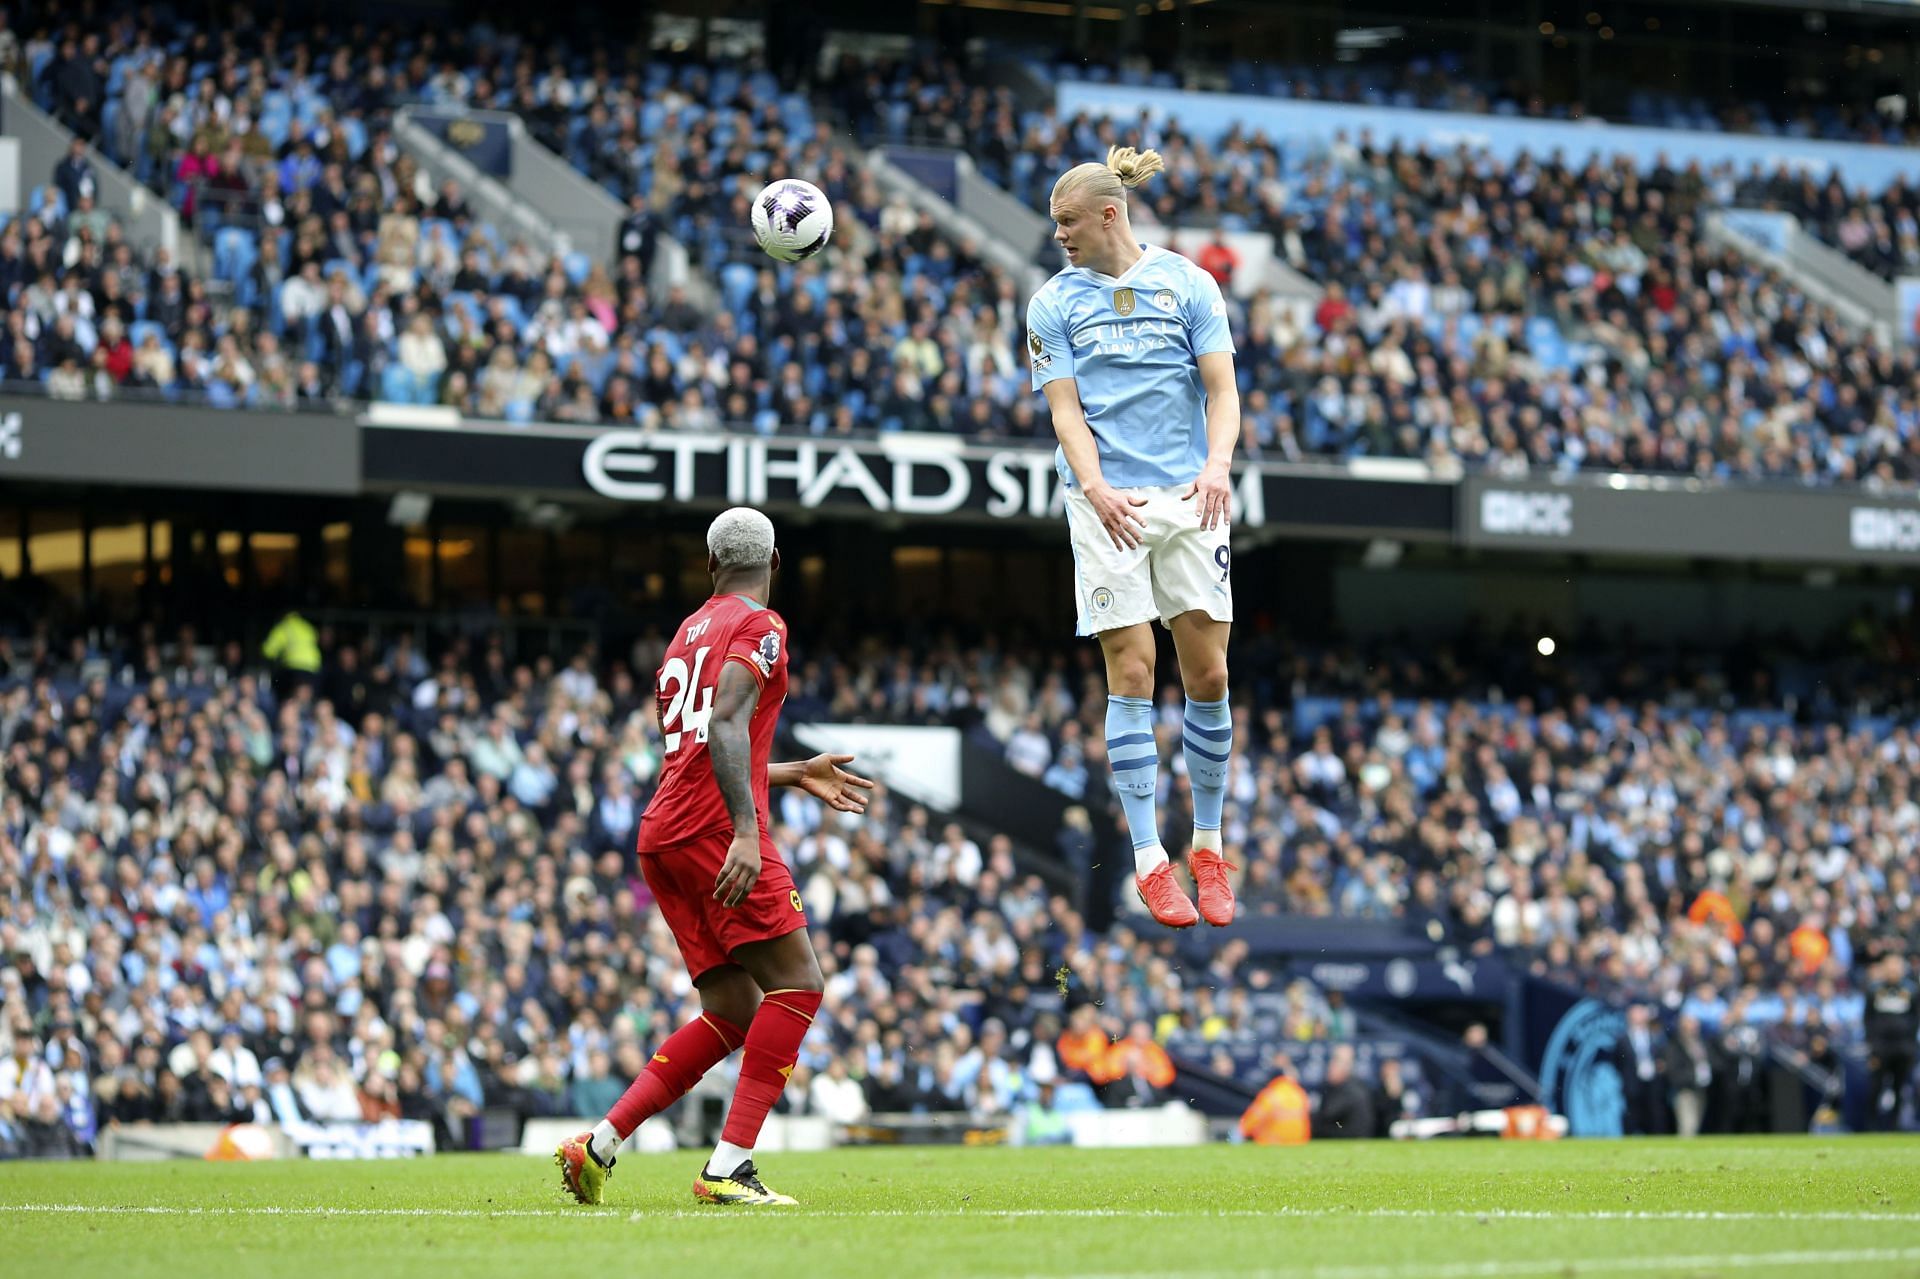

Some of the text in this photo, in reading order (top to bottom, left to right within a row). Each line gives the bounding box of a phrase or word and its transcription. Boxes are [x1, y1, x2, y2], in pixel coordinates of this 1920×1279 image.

[1073, 319, 1184, 348] ETIHAD
[1093, 338, 1167, 355] AIRWAYS
[583, 431, 971, 515] ETIHAD
[1214, 544, 1230, 583] 9
[659, 646, 714, 754] 24
